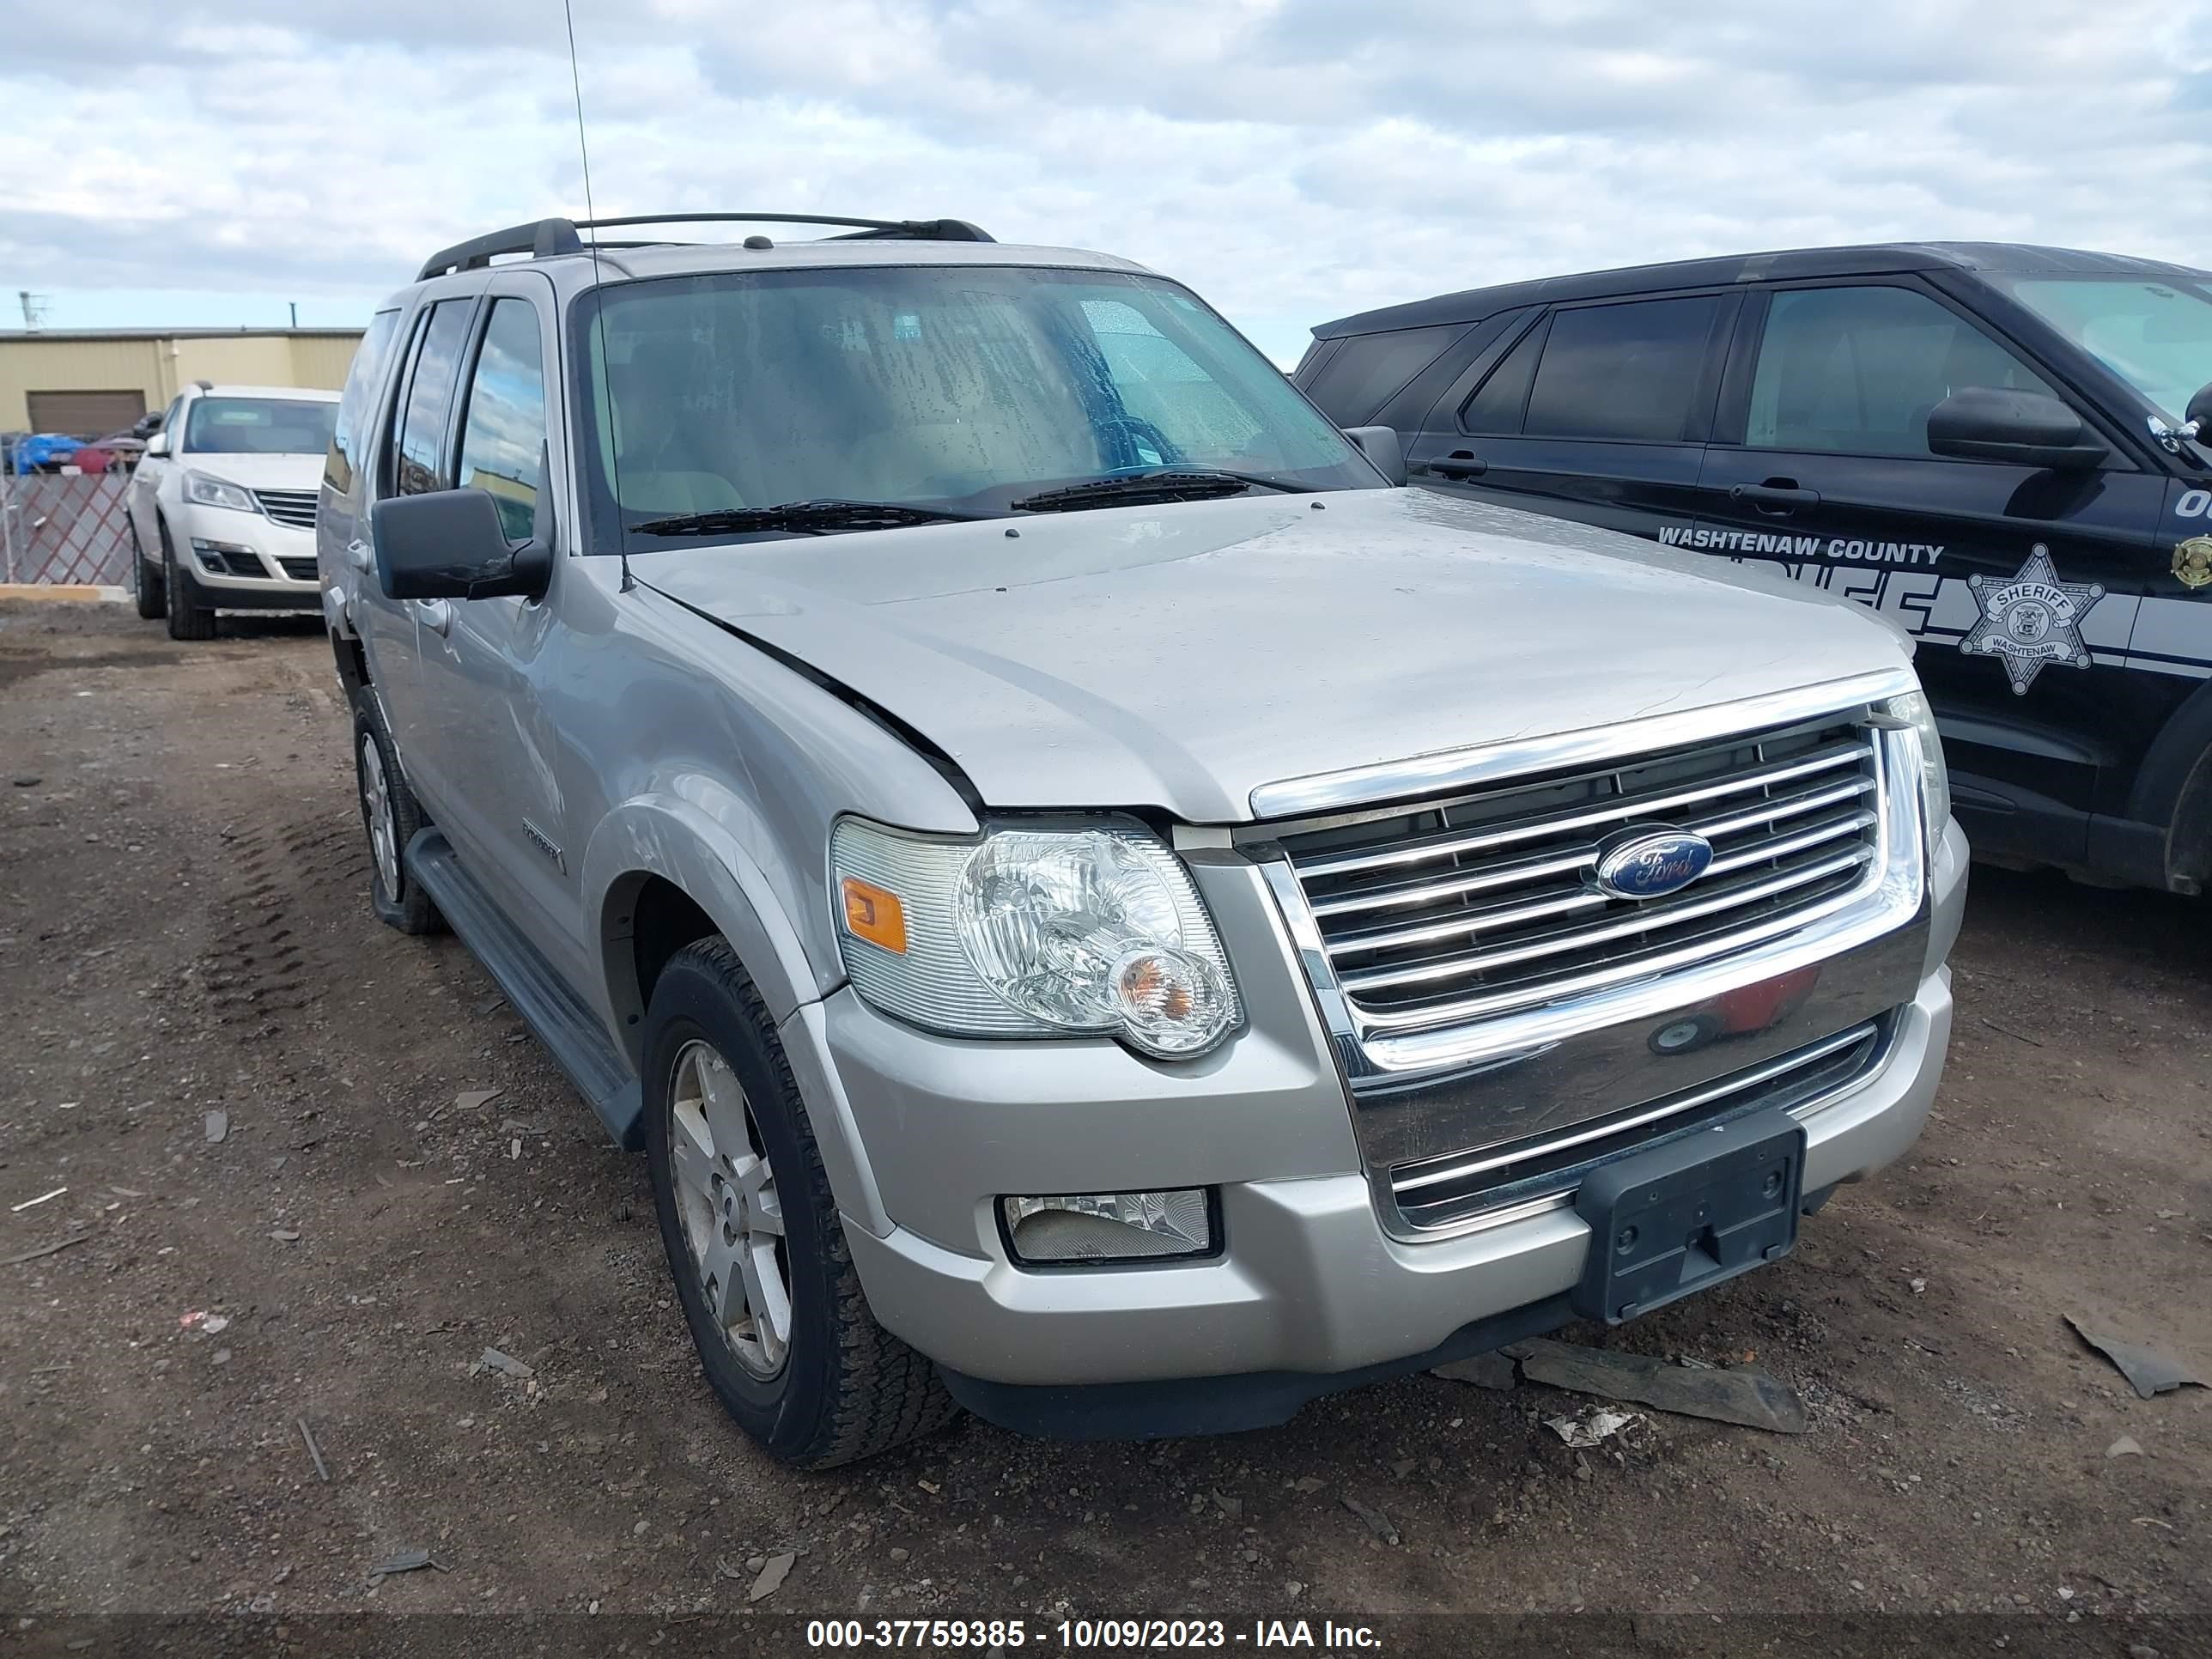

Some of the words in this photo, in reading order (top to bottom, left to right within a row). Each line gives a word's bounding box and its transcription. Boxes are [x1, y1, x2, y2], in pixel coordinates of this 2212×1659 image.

[1658, 526, 1820, 556] WASHTENAW
[1827, 538, 1944, 565] COUNTY
[1996, 585, 2069, 610] SHERIFF
[1992, 638, 2056, 657] WASHTENAW
[1635, 845, 1694, 887] Ford
